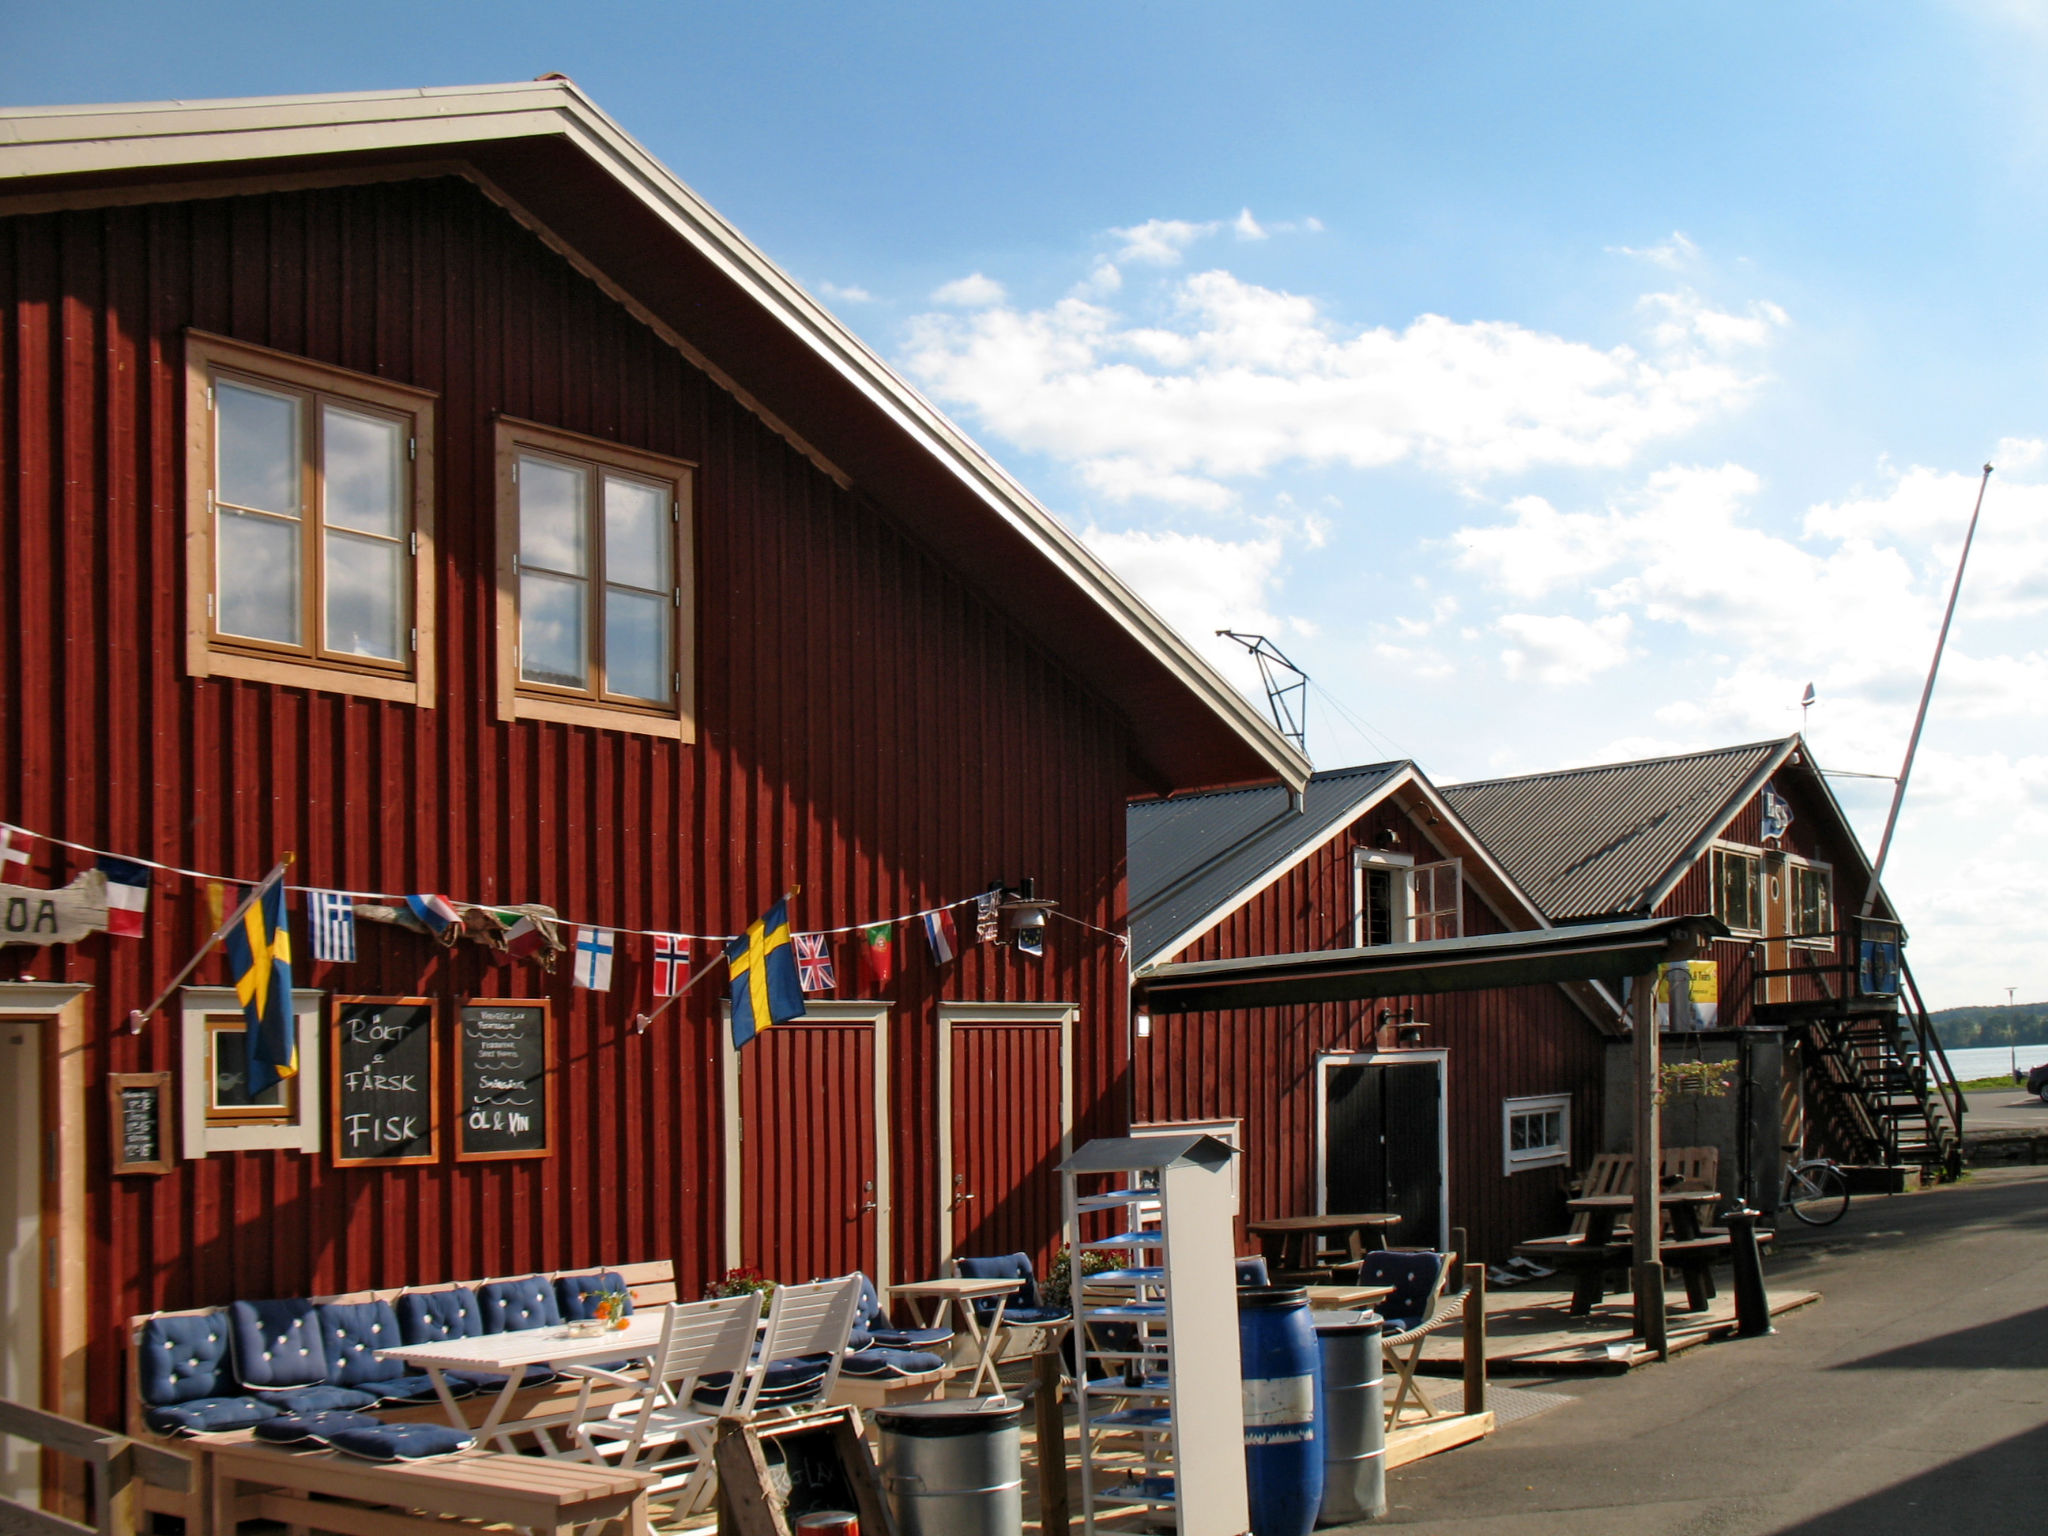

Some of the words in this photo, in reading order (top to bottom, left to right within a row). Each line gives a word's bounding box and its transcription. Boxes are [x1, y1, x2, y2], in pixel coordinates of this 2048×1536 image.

[347, 1015, 410, 1043] RÖKT
[344, 1065, 417, 1092] FÄRSK
[344, 1113, 418, 1147] FISK
[469, 1107, 490, 1130] ÖL
[508, 1112, 529, 1137] VIN
